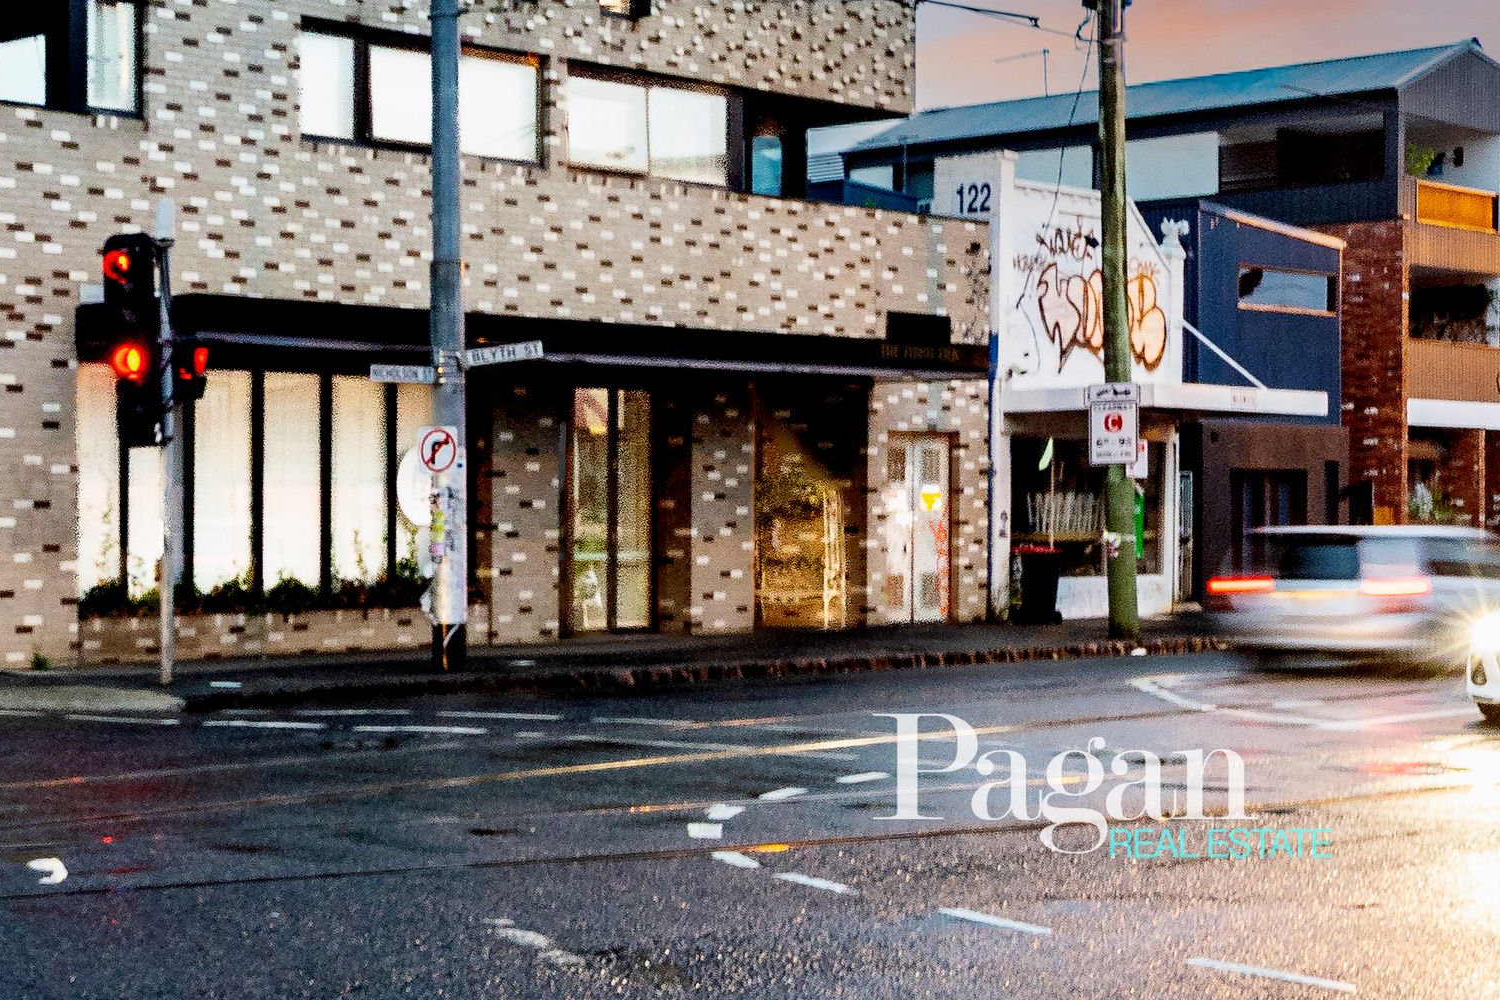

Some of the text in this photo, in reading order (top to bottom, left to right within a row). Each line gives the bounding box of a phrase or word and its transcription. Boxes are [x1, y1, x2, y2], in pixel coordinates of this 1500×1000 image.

[956, 183, 991, 214] 122
[472, 342, 538, 362] BLYTH ST
